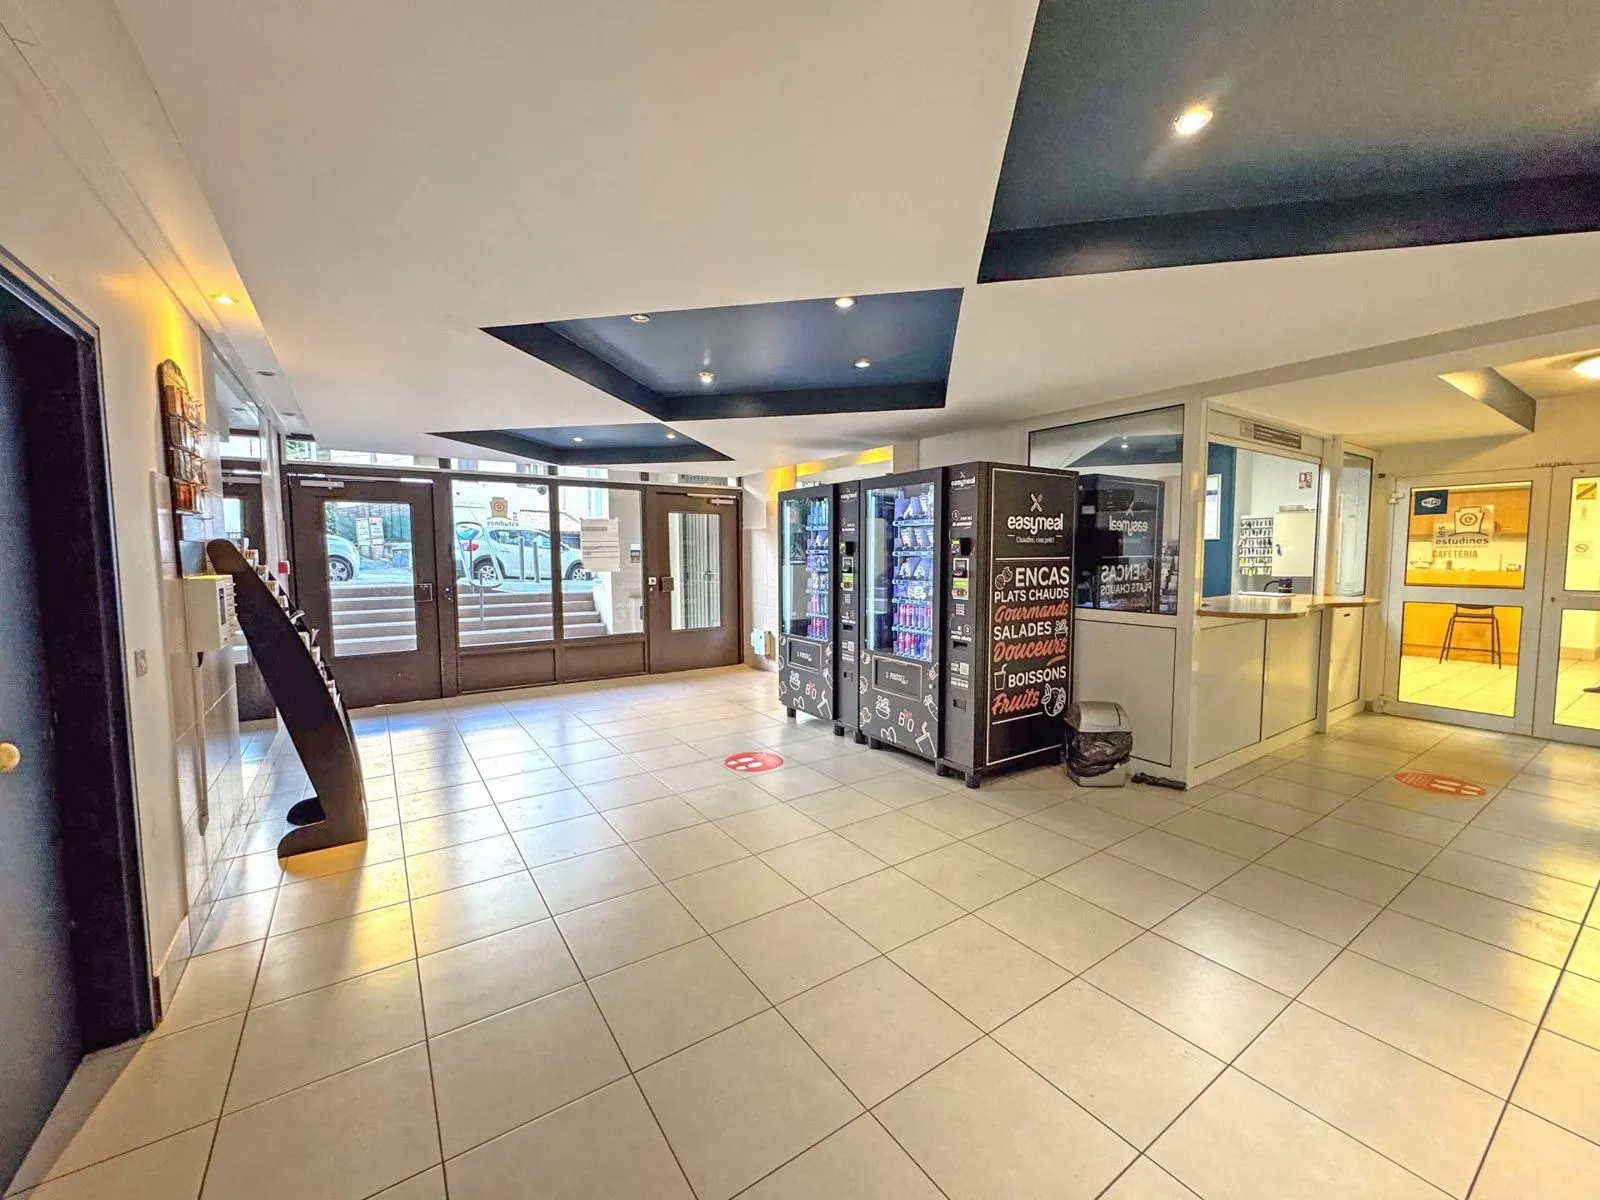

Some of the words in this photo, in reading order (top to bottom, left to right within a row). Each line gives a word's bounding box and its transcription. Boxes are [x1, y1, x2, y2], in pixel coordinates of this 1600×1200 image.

[1007, 512, 1064, 535] easymeal
[1015, 566, 1070, 587] ENCAS
[994, 589, 1027, 603] PLATS
[1028, 587, 1070, 600] CHAUDS
[994, 600, 1069, 622] Gourmands
[993, 620, 1052, 641] SALADES
[993, 637, 1068, 663] Douceurs
[1008, 665, 1067, 688] BOISSONS
[991, 688, 1040, 715] Fruits
